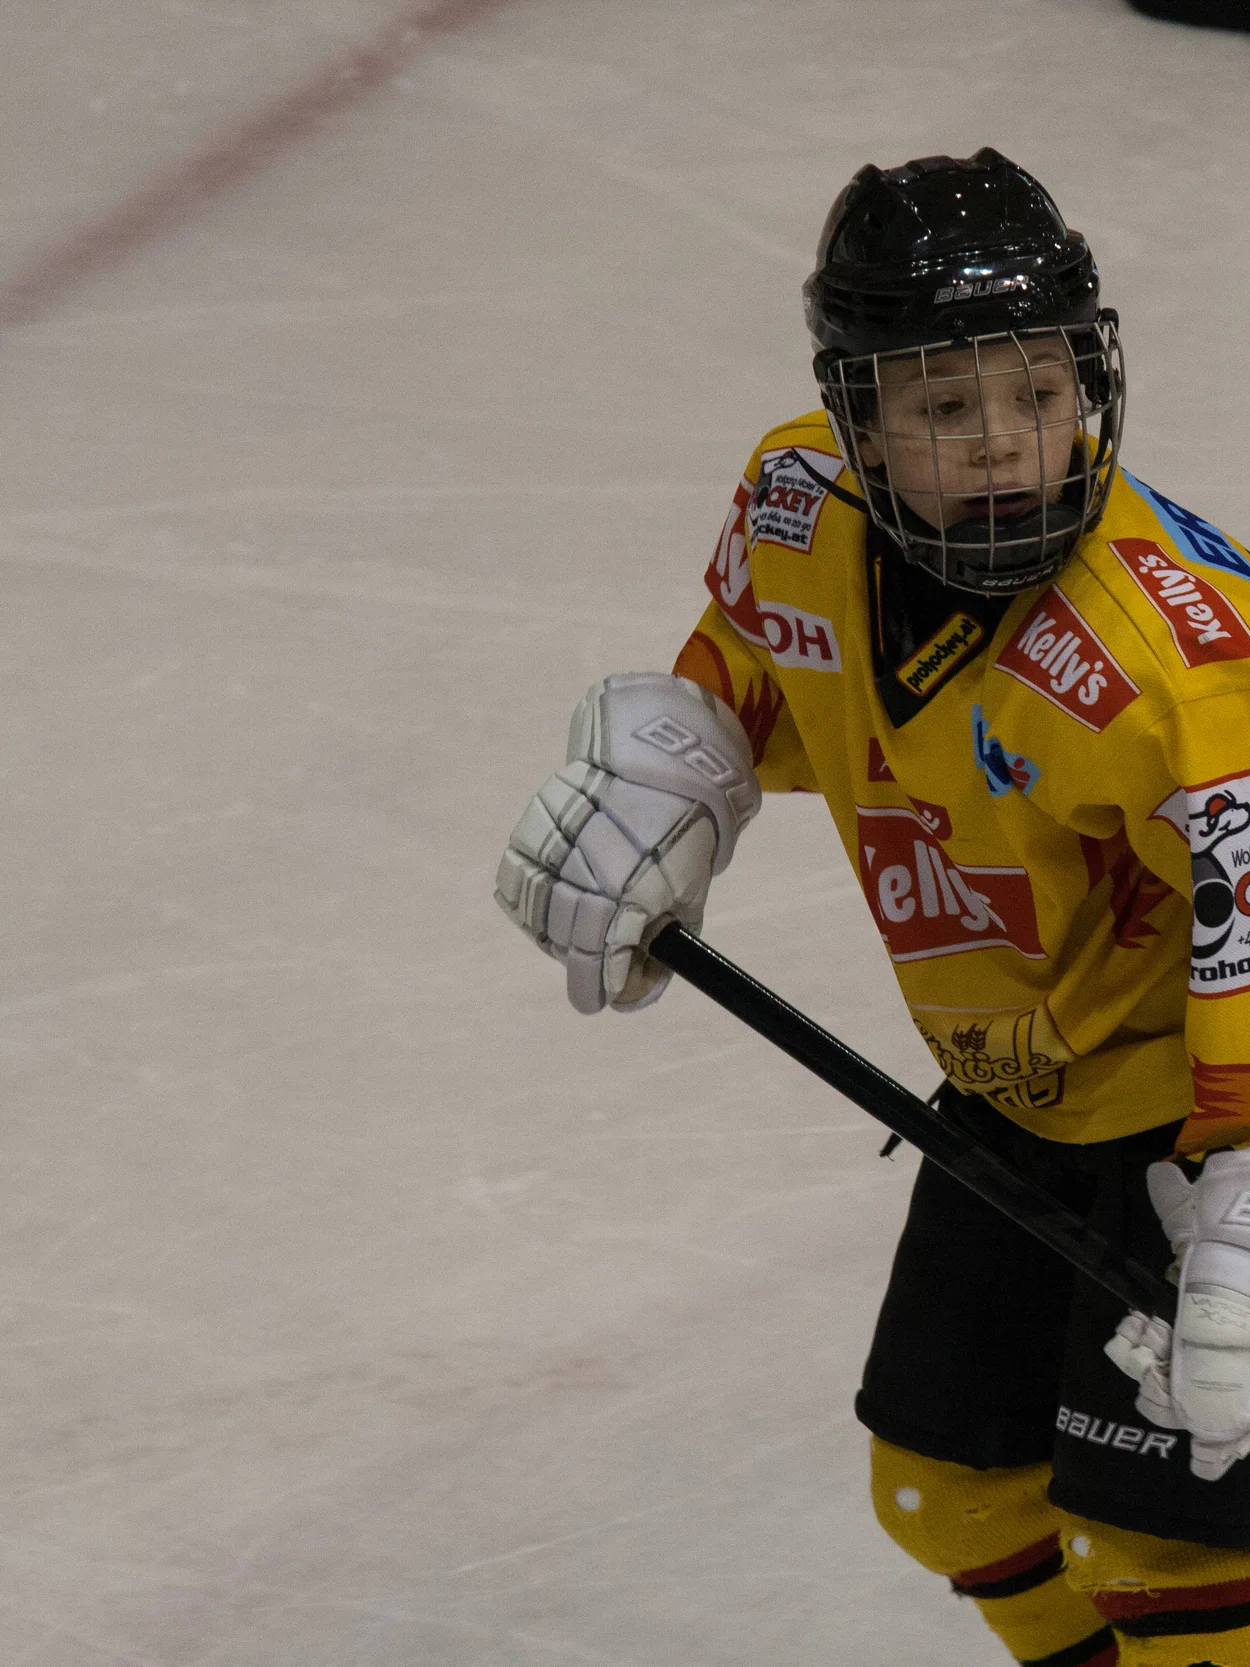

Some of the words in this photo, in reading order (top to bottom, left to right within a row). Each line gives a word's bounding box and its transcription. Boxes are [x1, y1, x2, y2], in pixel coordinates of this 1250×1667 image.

[1138, 553, 1232, 645] Kelly's
[906, 618, 977, 693] prohockey.at
[1017, 611, 1108, 706] Kelly's
[1056, 1404, 1178, 1460] BAUER
